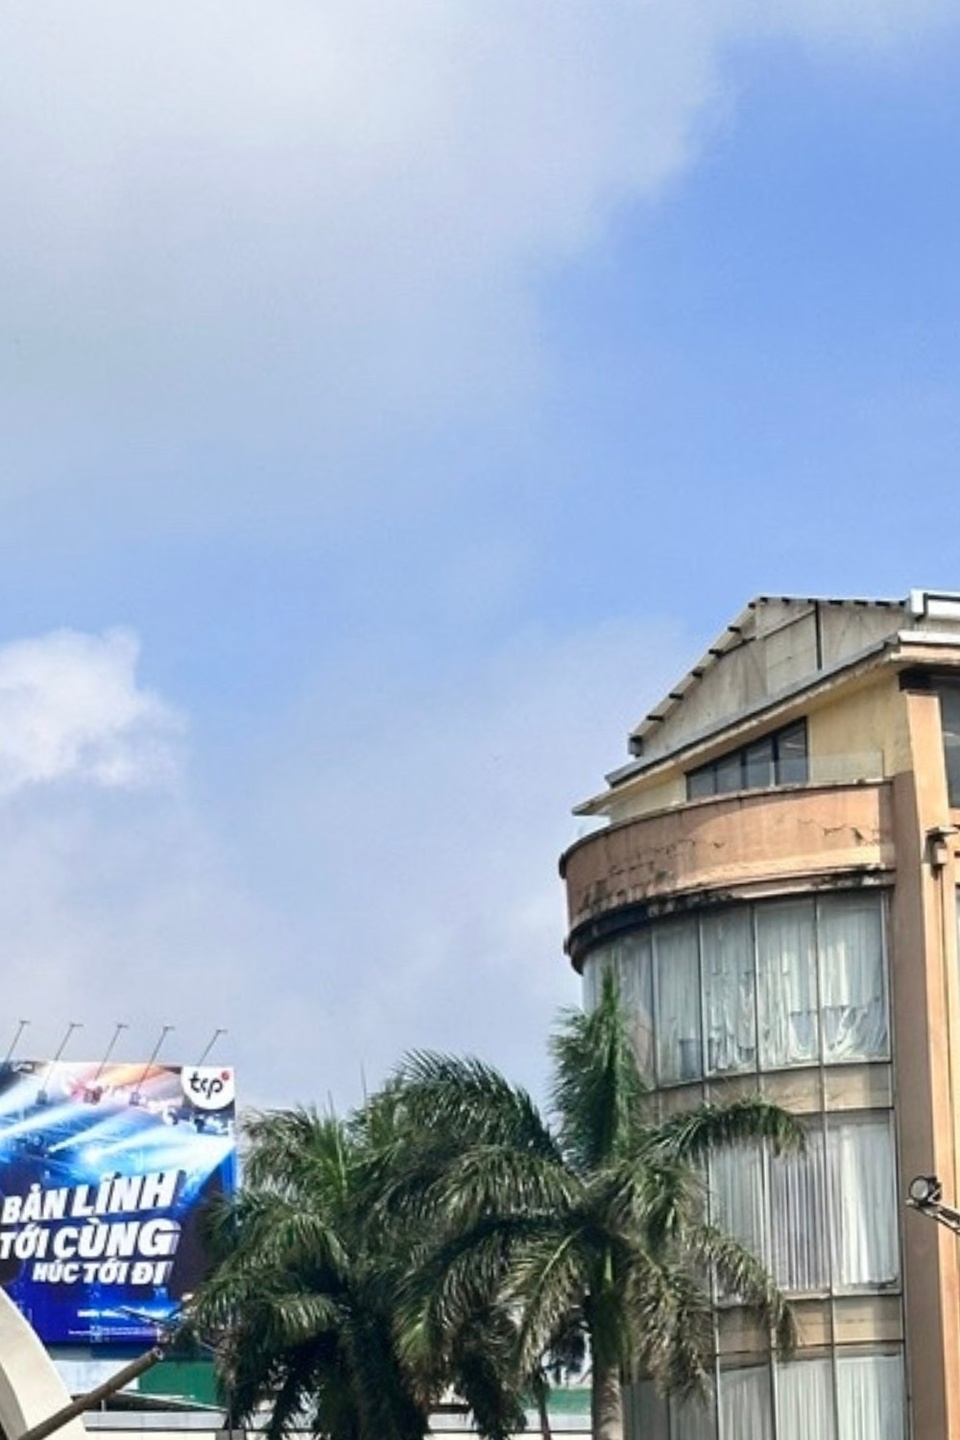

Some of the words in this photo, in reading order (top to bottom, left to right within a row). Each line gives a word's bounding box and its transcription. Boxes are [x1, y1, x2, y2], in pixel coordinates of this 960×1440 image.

[0, 1183, 69, 1224] BẢN
[53, 1217, 179, 1259] CÙNG
[32, 1260, 79, 1284] HÚC
[82, 1257, 129, 1285] TỚI
[131, 1261, 169, 1285] ĐI
